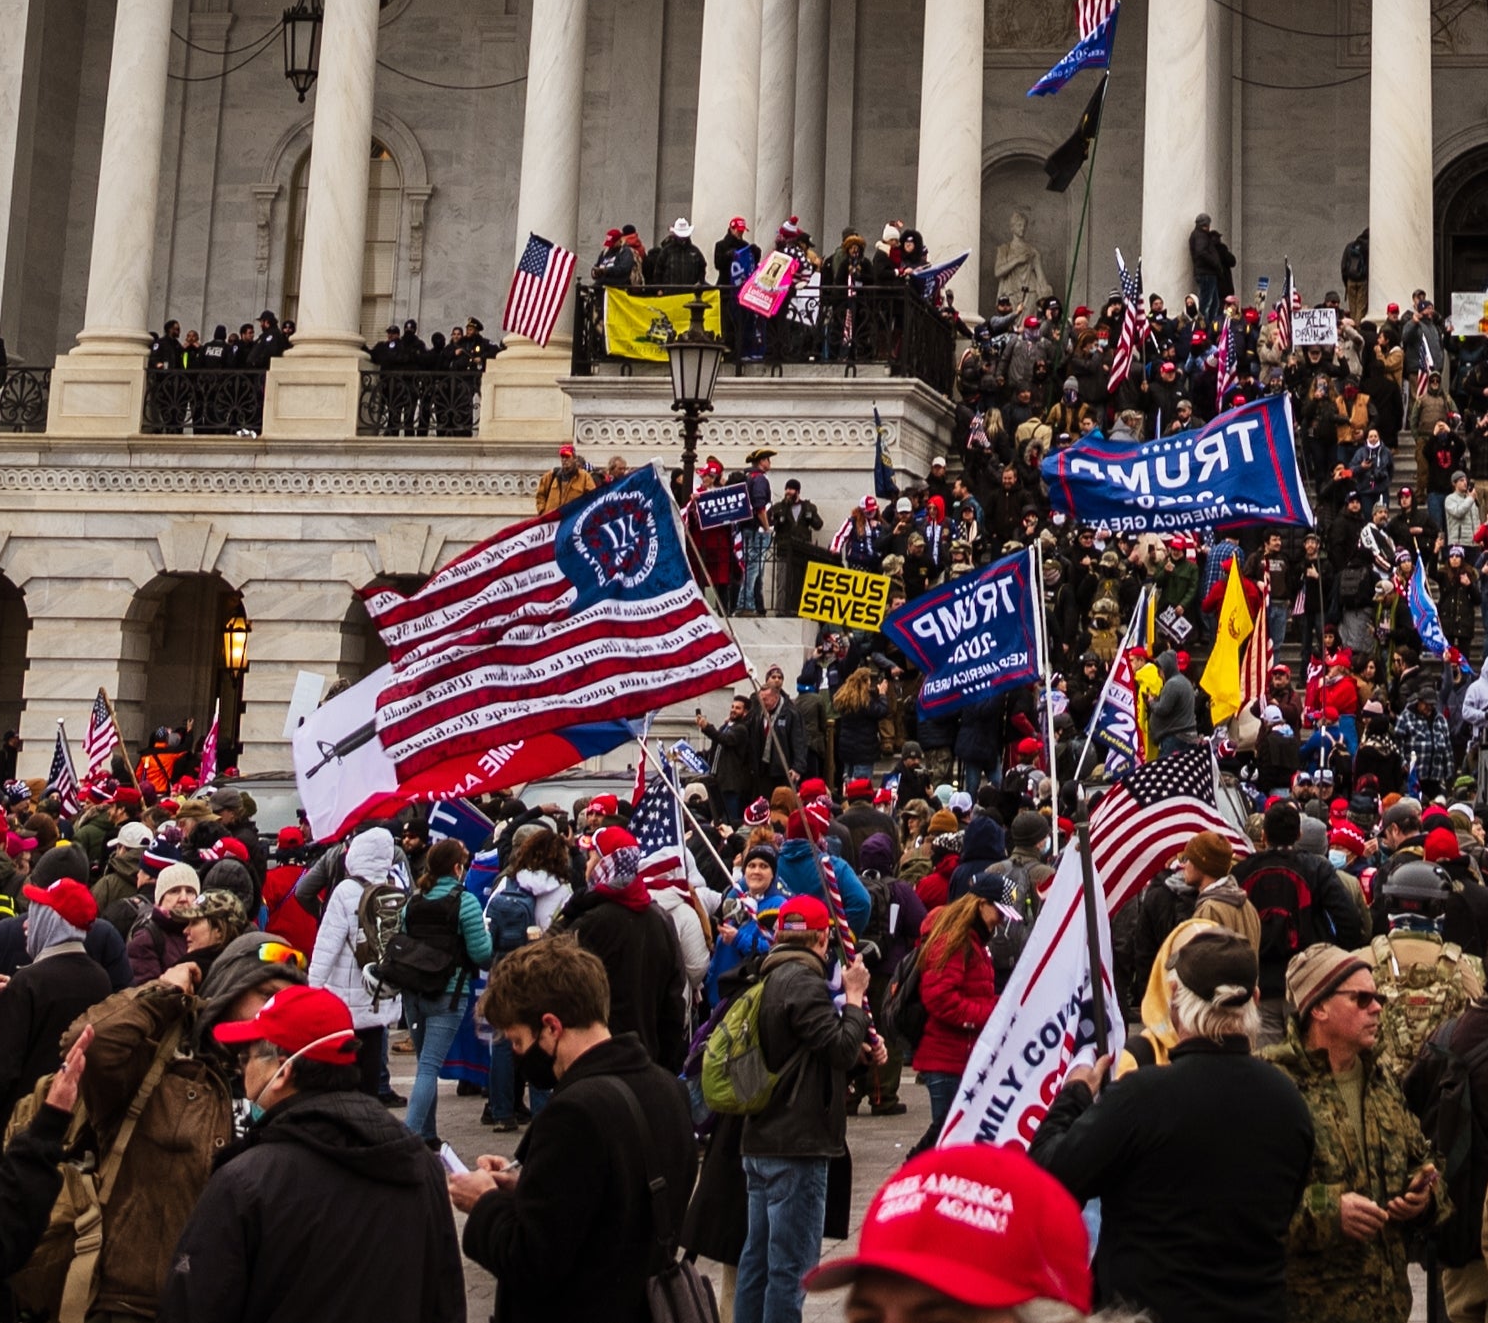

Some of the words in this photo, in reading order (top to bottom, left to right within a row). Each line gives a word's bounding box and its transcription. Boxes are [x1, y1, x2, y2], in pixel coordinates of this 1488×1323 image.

[699, 492, 747, 509] TRUMP
[704, 501, 744, 515] PENCE
[808, 568, 886, 602] JESUS
[802, 591, 883, 626] SAVES
[920, 1172, 1014, 1213] AMERICA
[935, 1196, 1009, 1235] AGAIN!
